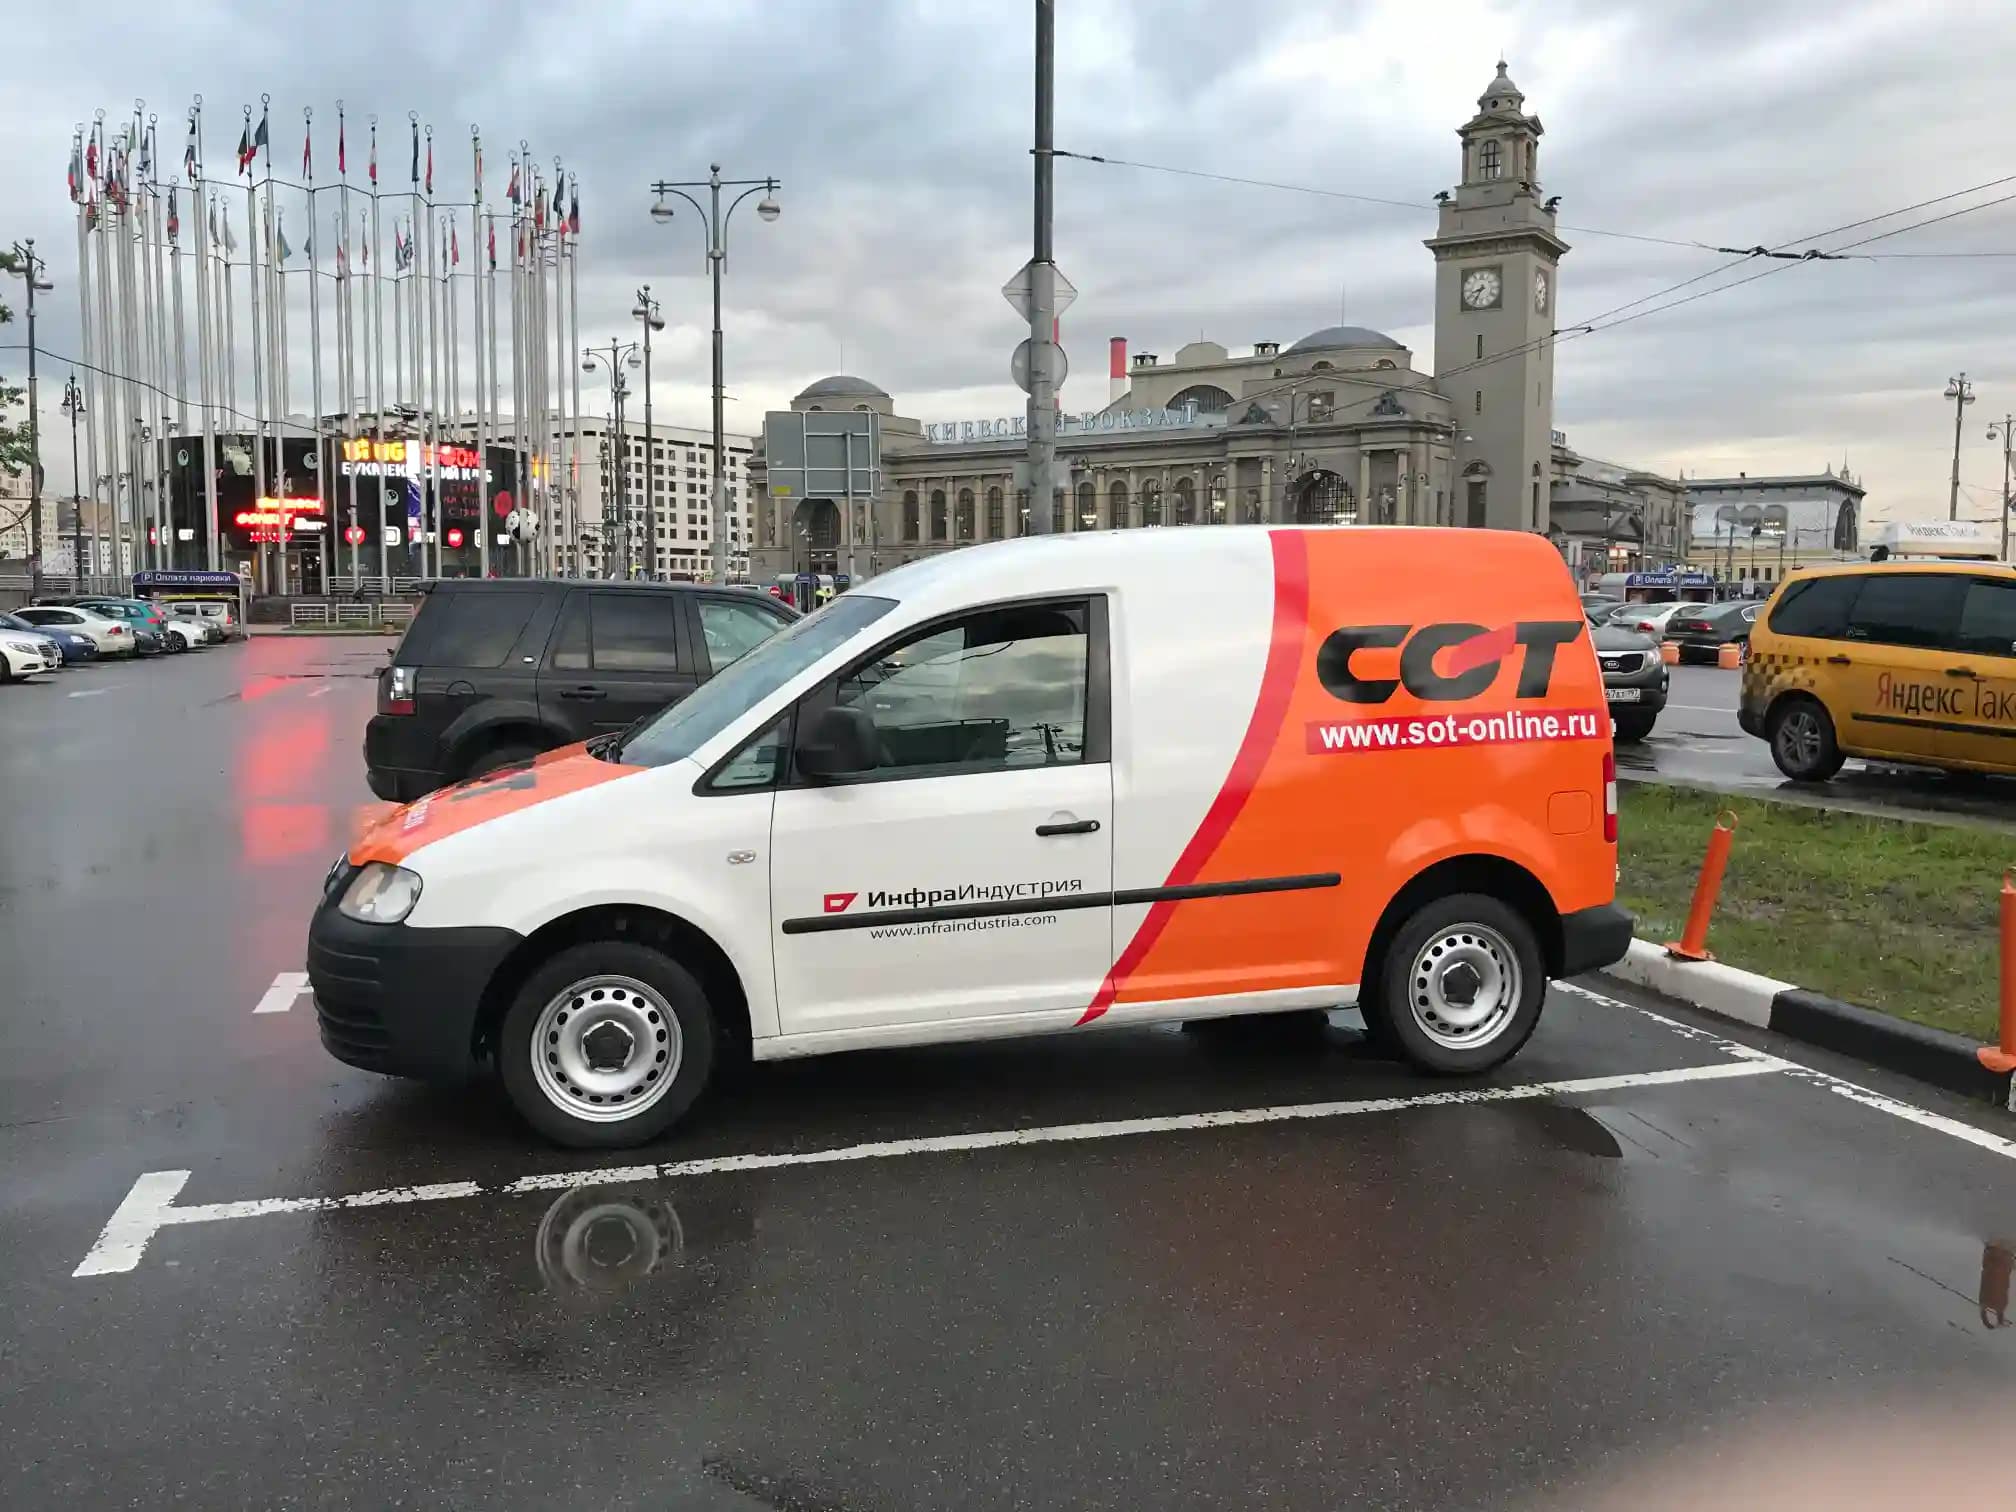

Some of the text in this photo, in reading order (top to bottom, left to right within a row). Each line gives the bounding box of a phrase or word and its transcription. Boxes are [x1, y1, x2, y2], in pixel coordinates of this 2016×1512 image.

[1080, 404, 1194, 431] ВОКЗАЛ
[155, 573, 187, 582] Оплата
[189, 574, 231, 583] парковки
[1876, 671, 1965, 715] Яндекс
[1320, 711, 1597, 748] www.sot-online.ru
[868, 878, 1082, 909] ИнфраИндустрия
[870, 913, 1057, 940] www.infraindustria.com
